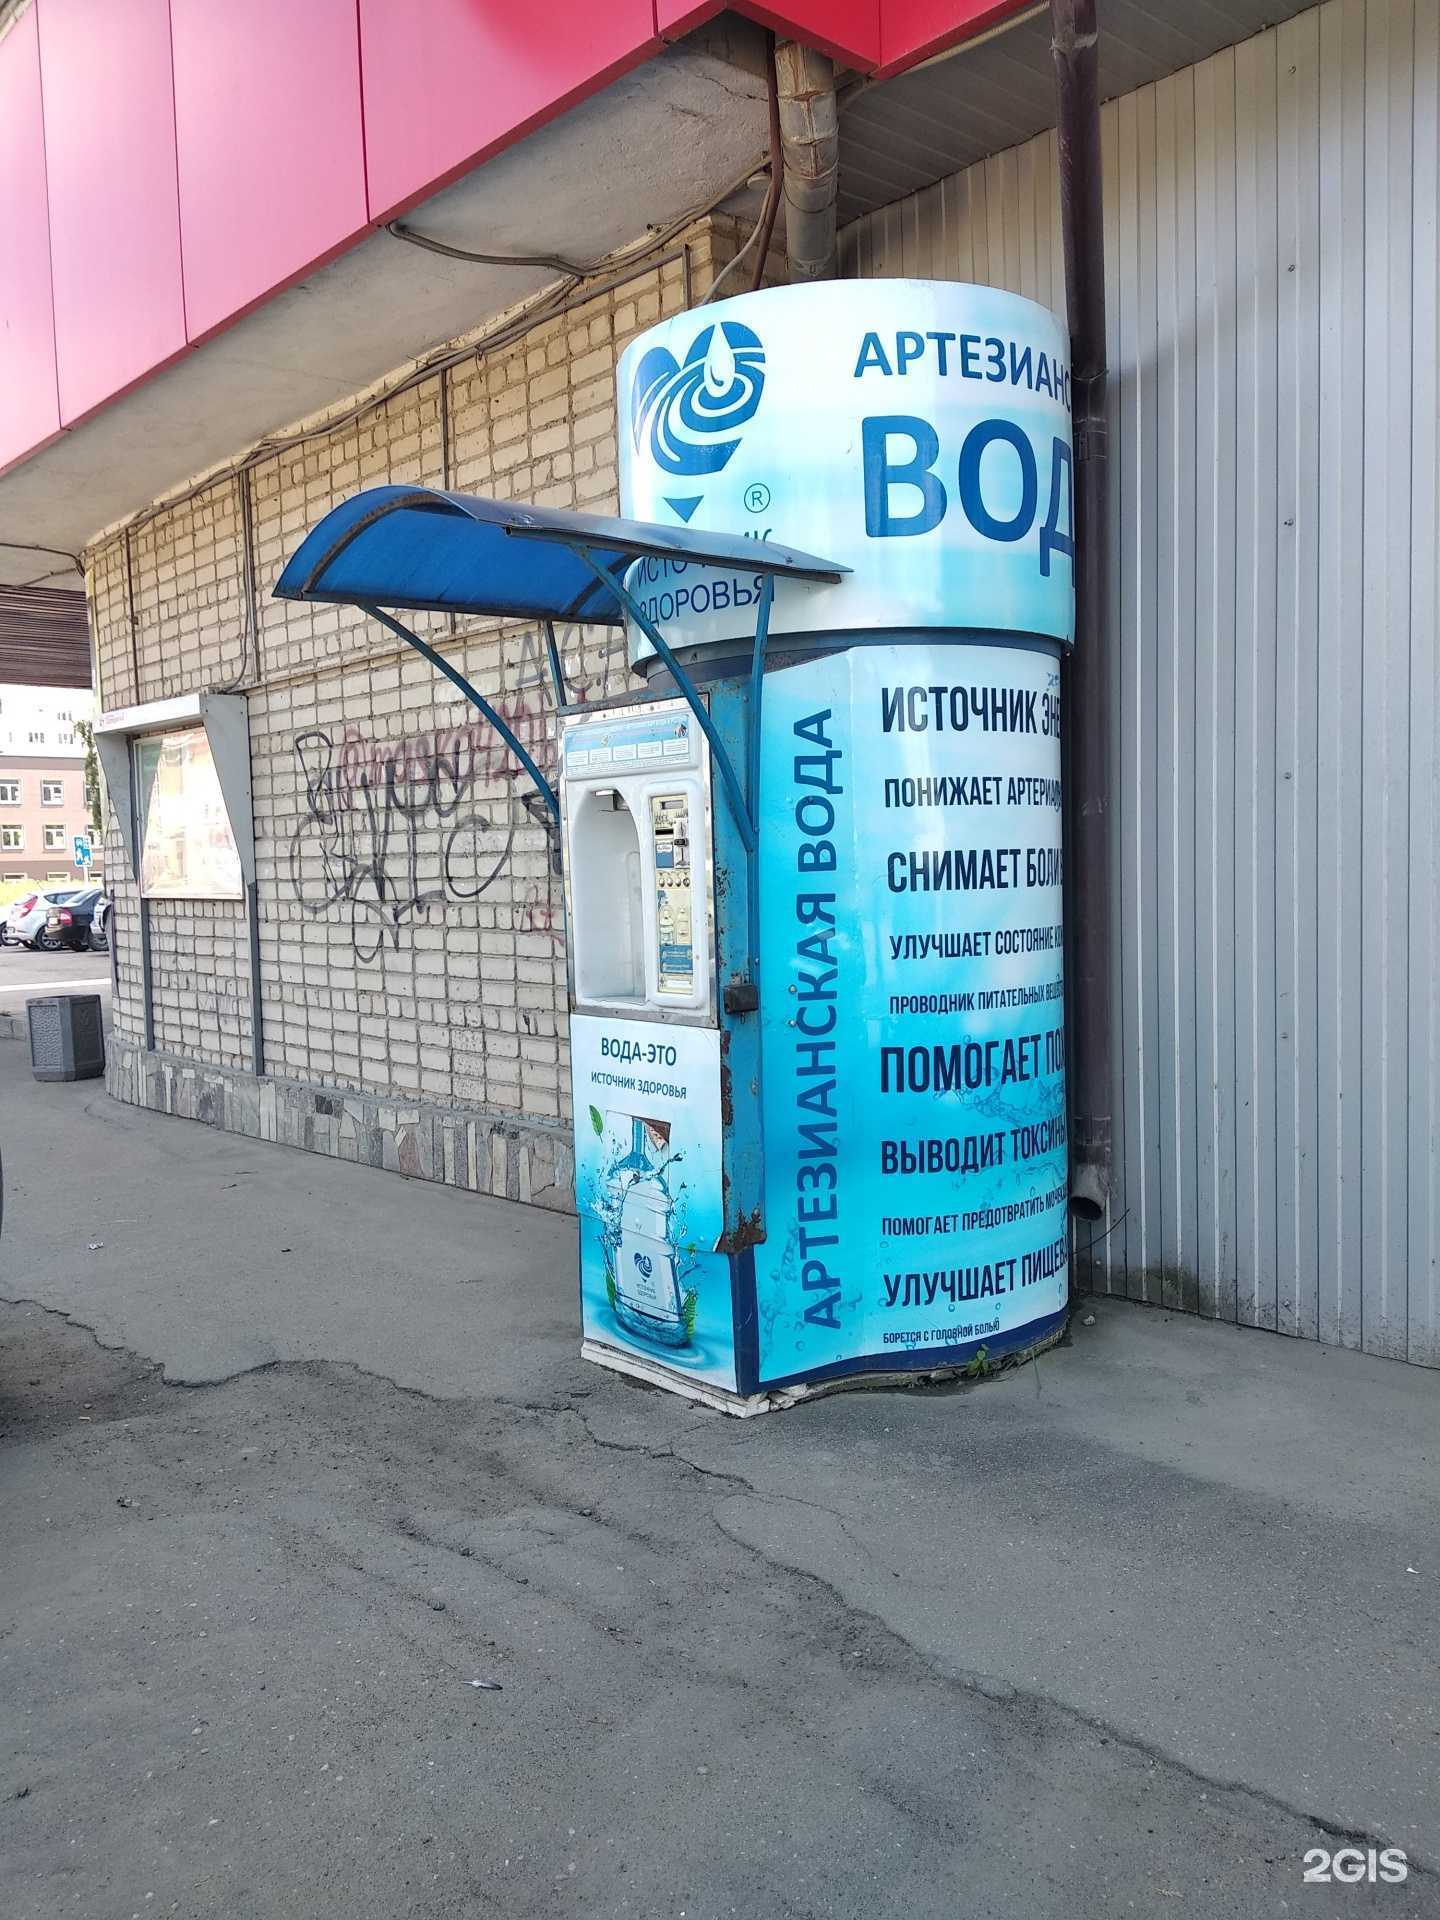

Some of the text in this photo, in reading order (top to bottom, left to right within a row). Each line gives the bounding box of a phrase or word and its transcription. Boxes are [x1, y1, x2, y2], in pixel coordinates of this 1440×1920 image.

[881, 686, 1038, 735] ИСТОЧНИК
[884, 776, 1003, 808] ПОНИЖАЕТ
[887, 848, 1021, 893] СНИМАЕТ
[889, 932, 992, 960] УЛУЧШАЕТ
[995, 926, 1054, 955] СОСТОЯНИЕ
[793, 708, 844, 1329] АРТЕЗИАНСКАЯ ВОДА
[889, 992, 975, 1016] ПРОВОДНИК
[978, 984, 1045, 1010] ПИТАТЕЛЬНЫХ
[601, 1036, 677, 1066] ВОДА-ЭТО
[880, 1033, 1042, 1094] ПОМОГАЕТ
[591, 1071, 687, 1100] ИСТОЧНИК ЗДОРОВЬЯ
[881, 1131, 1006, 1175] ВЫВОДИТ
[882, 1216, 958, 1237] ПОМОГАЕТ
[962, 1196, 1045, 1232] ПРЕДОТВРАТИТЬ
[883, 1258, 1017, 1308] УЛУЧШАЕТ
[883, 1320, 1000, 1344] БОРЕТСЯ С ГОЛОВНОЙ БОЛЬЮ
